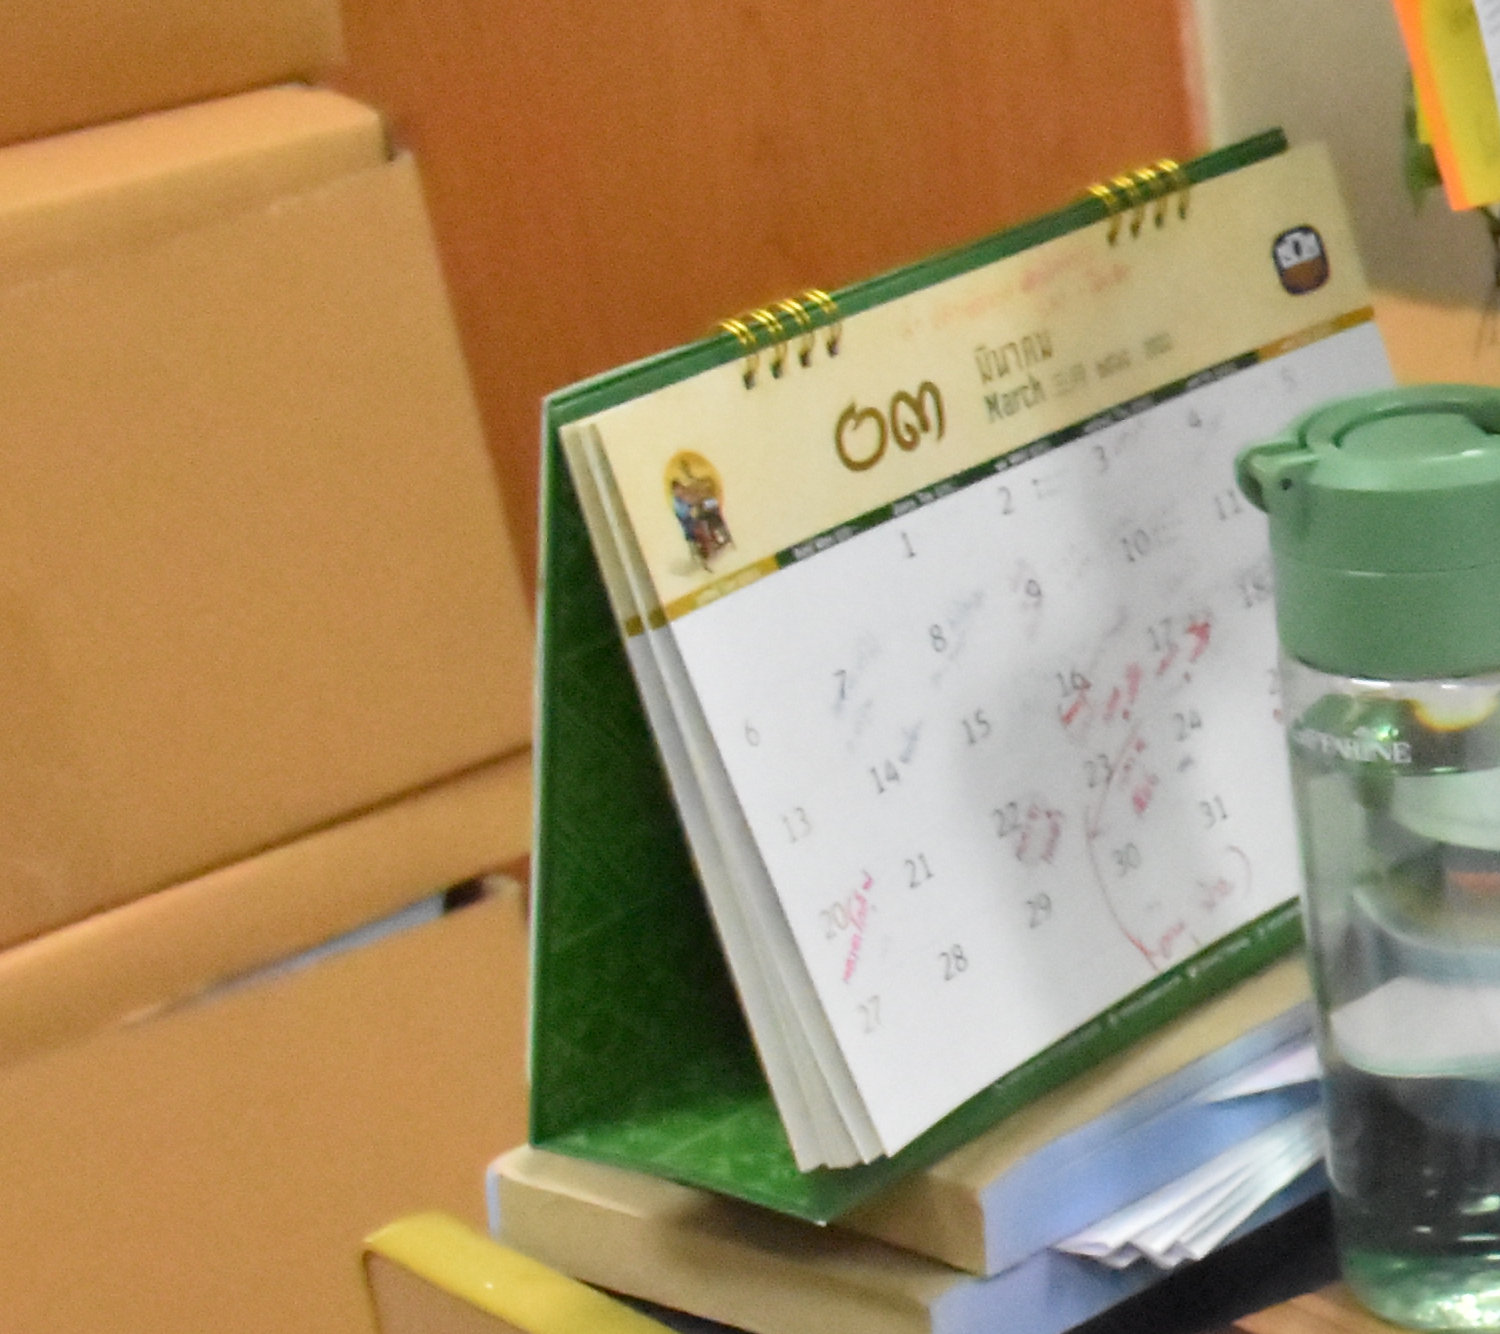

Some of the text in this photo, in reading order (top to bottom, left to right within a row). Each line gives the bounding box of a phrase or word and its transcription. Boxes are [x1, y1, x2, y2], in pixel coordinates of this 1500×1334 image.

[975, 324, 1055, 388] มีนาคม
[983, 372, 1047, 426] March
[996, 485, 1013, 517] 2
[1092, 445, 1110, 474] 3
[867, 759, 902, 797] 14
[960, 710, 992, 747] 15
[904, 851, 935, 890] 21
[937, 944, 969, 982] 28
[1200, 793, 1229, 830] 31
